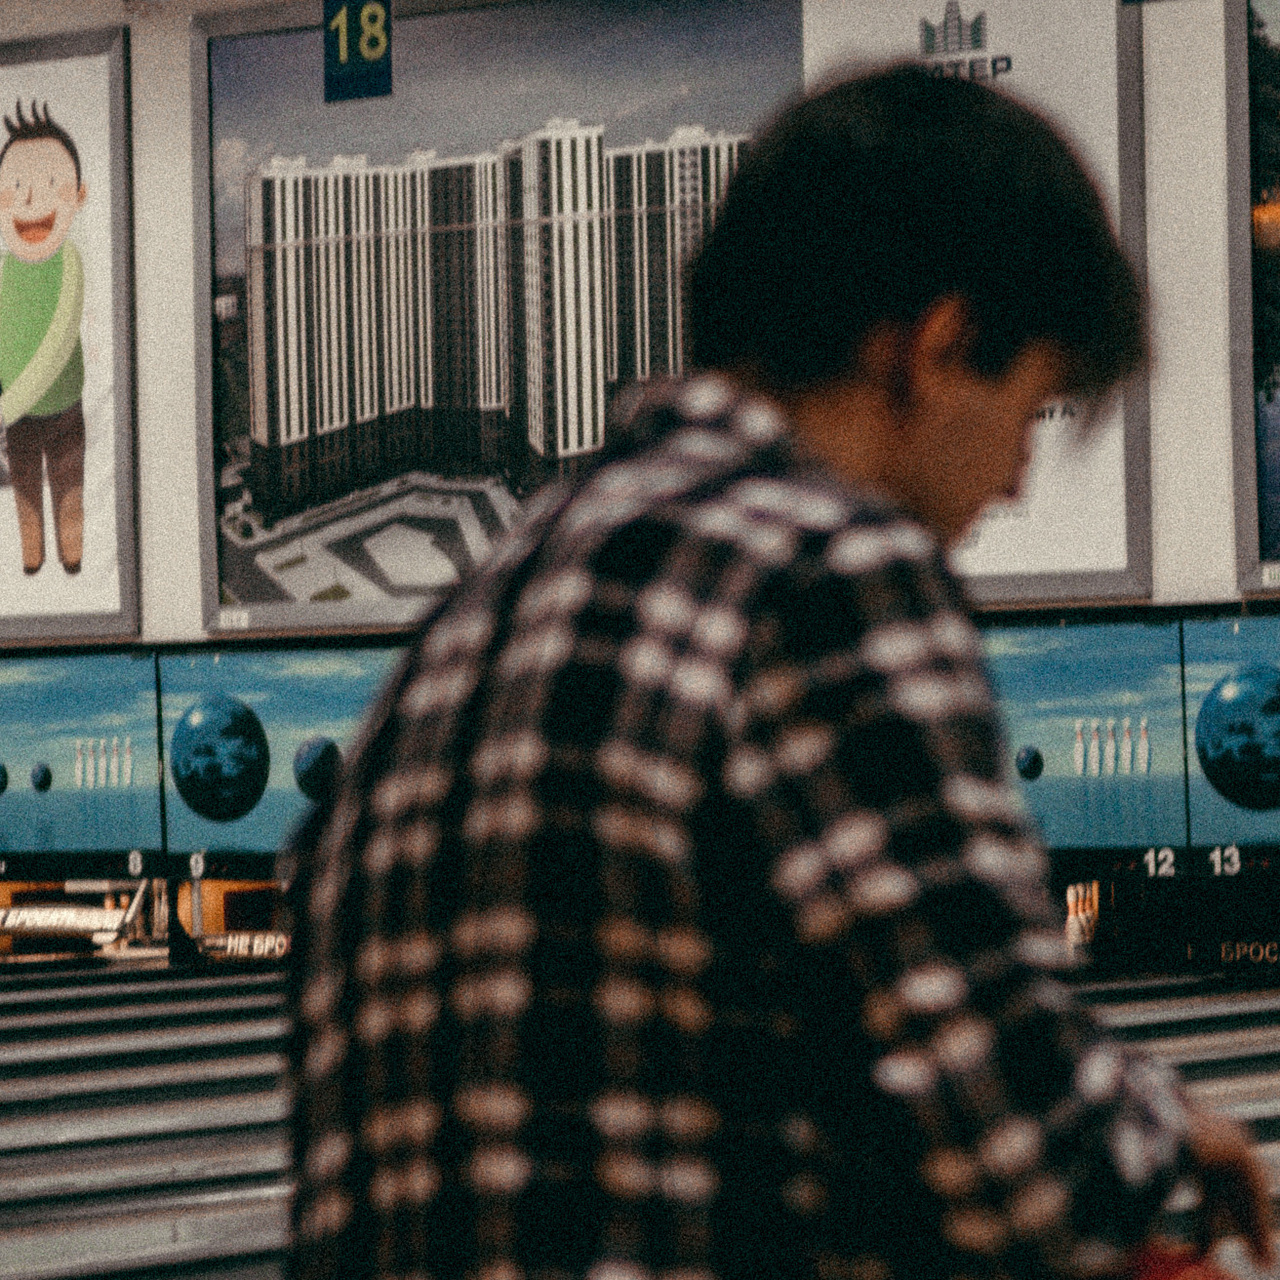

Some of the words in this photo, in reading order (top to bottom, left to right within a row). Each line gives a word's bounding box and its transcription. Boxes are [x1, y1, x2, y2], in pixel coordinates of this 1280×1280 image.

[329, 1, 388, 64] 18
[1143, 846, 1175, 877] 12
[1209, 845, 1241, 877] 13
